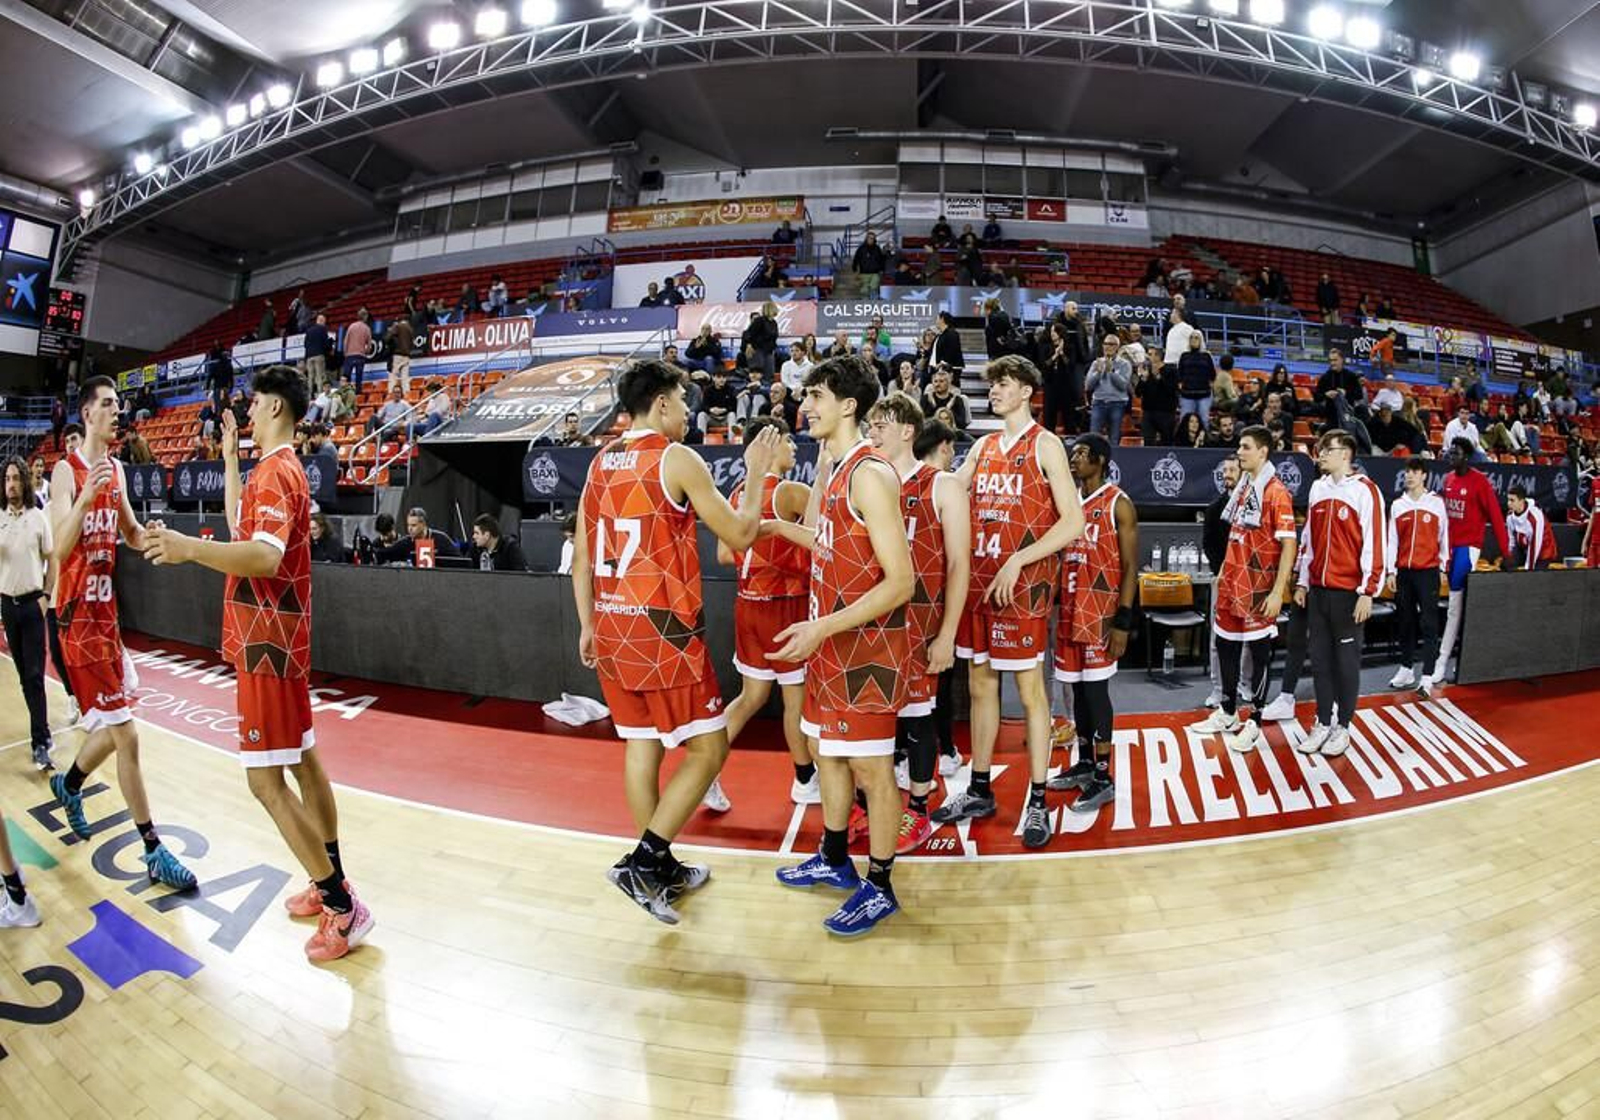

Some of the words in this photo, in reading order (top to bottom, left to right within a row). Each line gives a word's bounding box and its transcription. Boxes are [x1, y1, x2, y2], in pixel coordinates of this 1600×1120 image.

[823, 303, 852, 317] CAL
[854, 303, 932, 317] SPAGUETTI
[577, 317, 629, 327] VOLVO
[976, 473, 1023, 496] BAXI
[1152, 467, 1184, 482] BAXI
[83, 509, 118, 538] BAXI
[974, 532, 1001, 559] 14
[418, 546, 433, 568] 5
[85, 574, 113, 602] 20
[1346, 697, 1529, 800] DAMM
[925, 838, 957, 850] 1876
